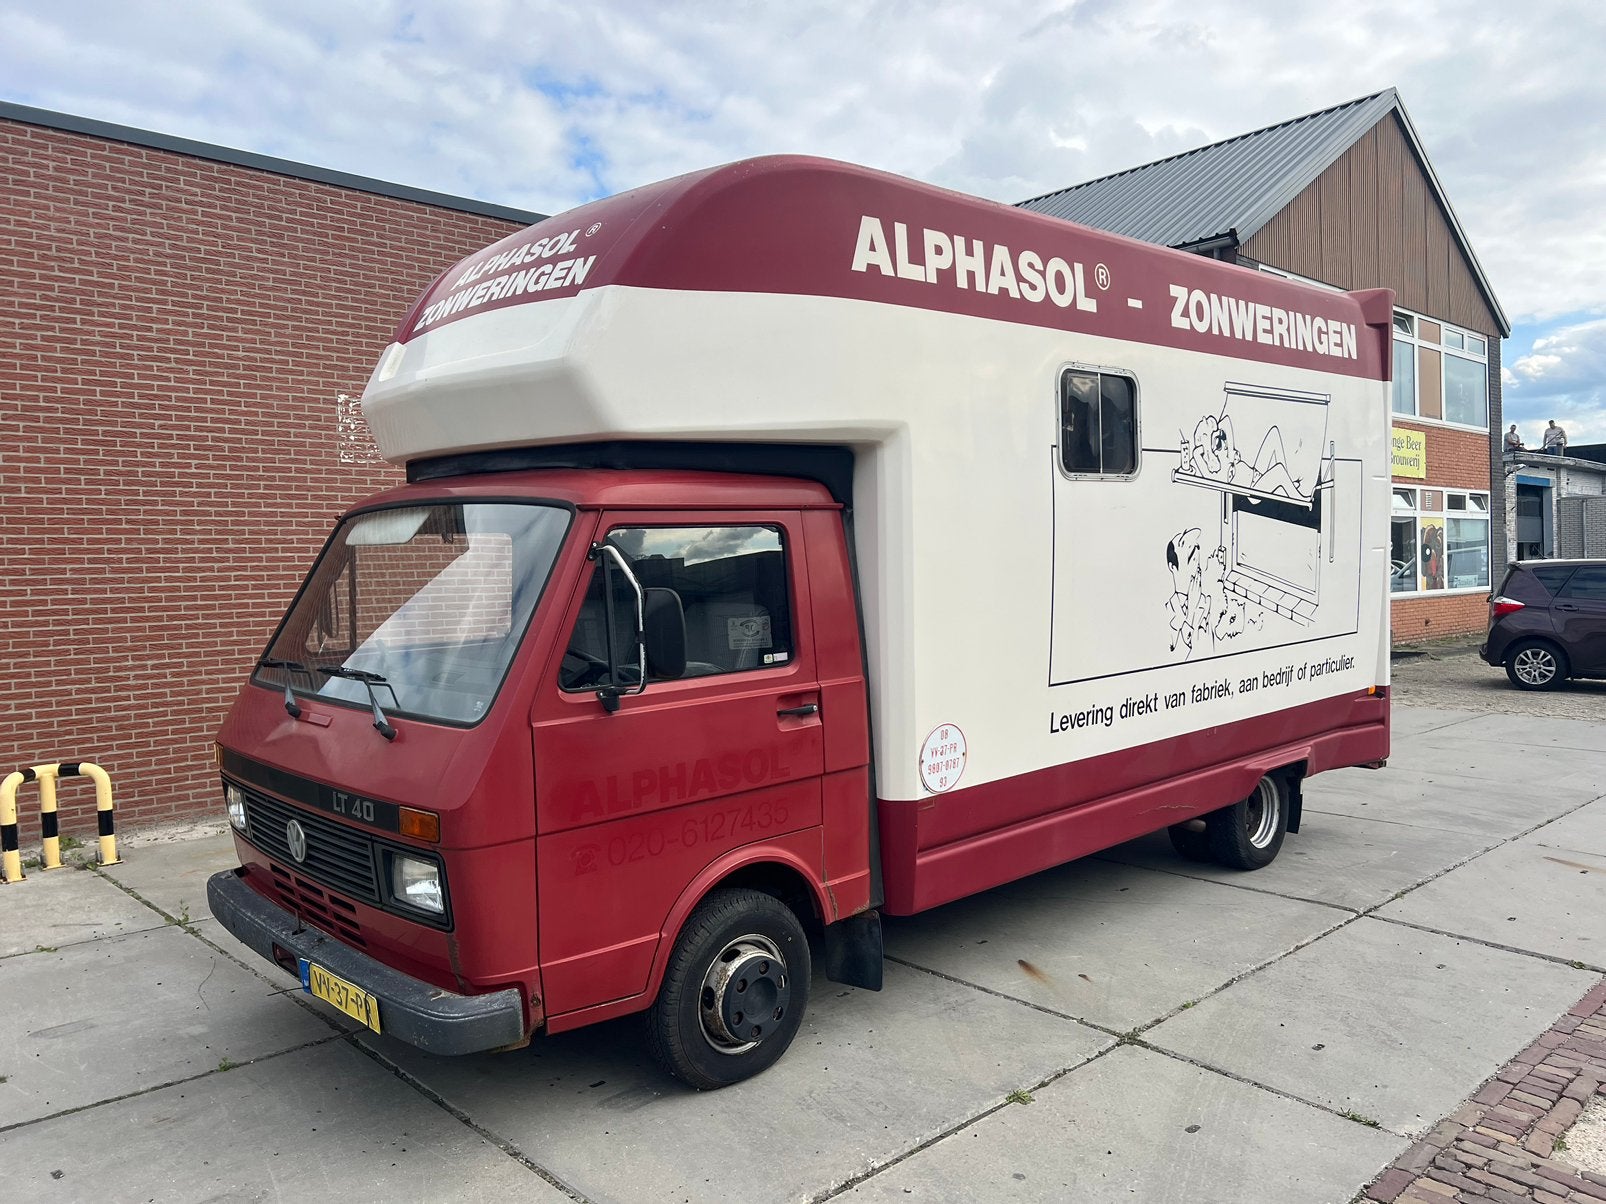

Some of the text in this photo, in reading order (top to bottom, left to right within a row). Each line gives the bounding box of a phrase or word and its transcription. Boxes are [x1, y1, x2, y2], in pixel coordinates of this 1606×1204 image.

[412, 254, 597, 333] ZONWERINGEN
[1168, 283, 1358, 361] ZONWERINGEN
[1392, 435, 1422, 451] nge Beer
[1049, 655, 1356, 734] Levering direkt van fabriek, aan bedrijf of particulier.
[332, 791, 375, 822] LT 40
[608, 799, 790, 867] 020-6127435
[313, 969, 376, 1027] VV-37-PR
